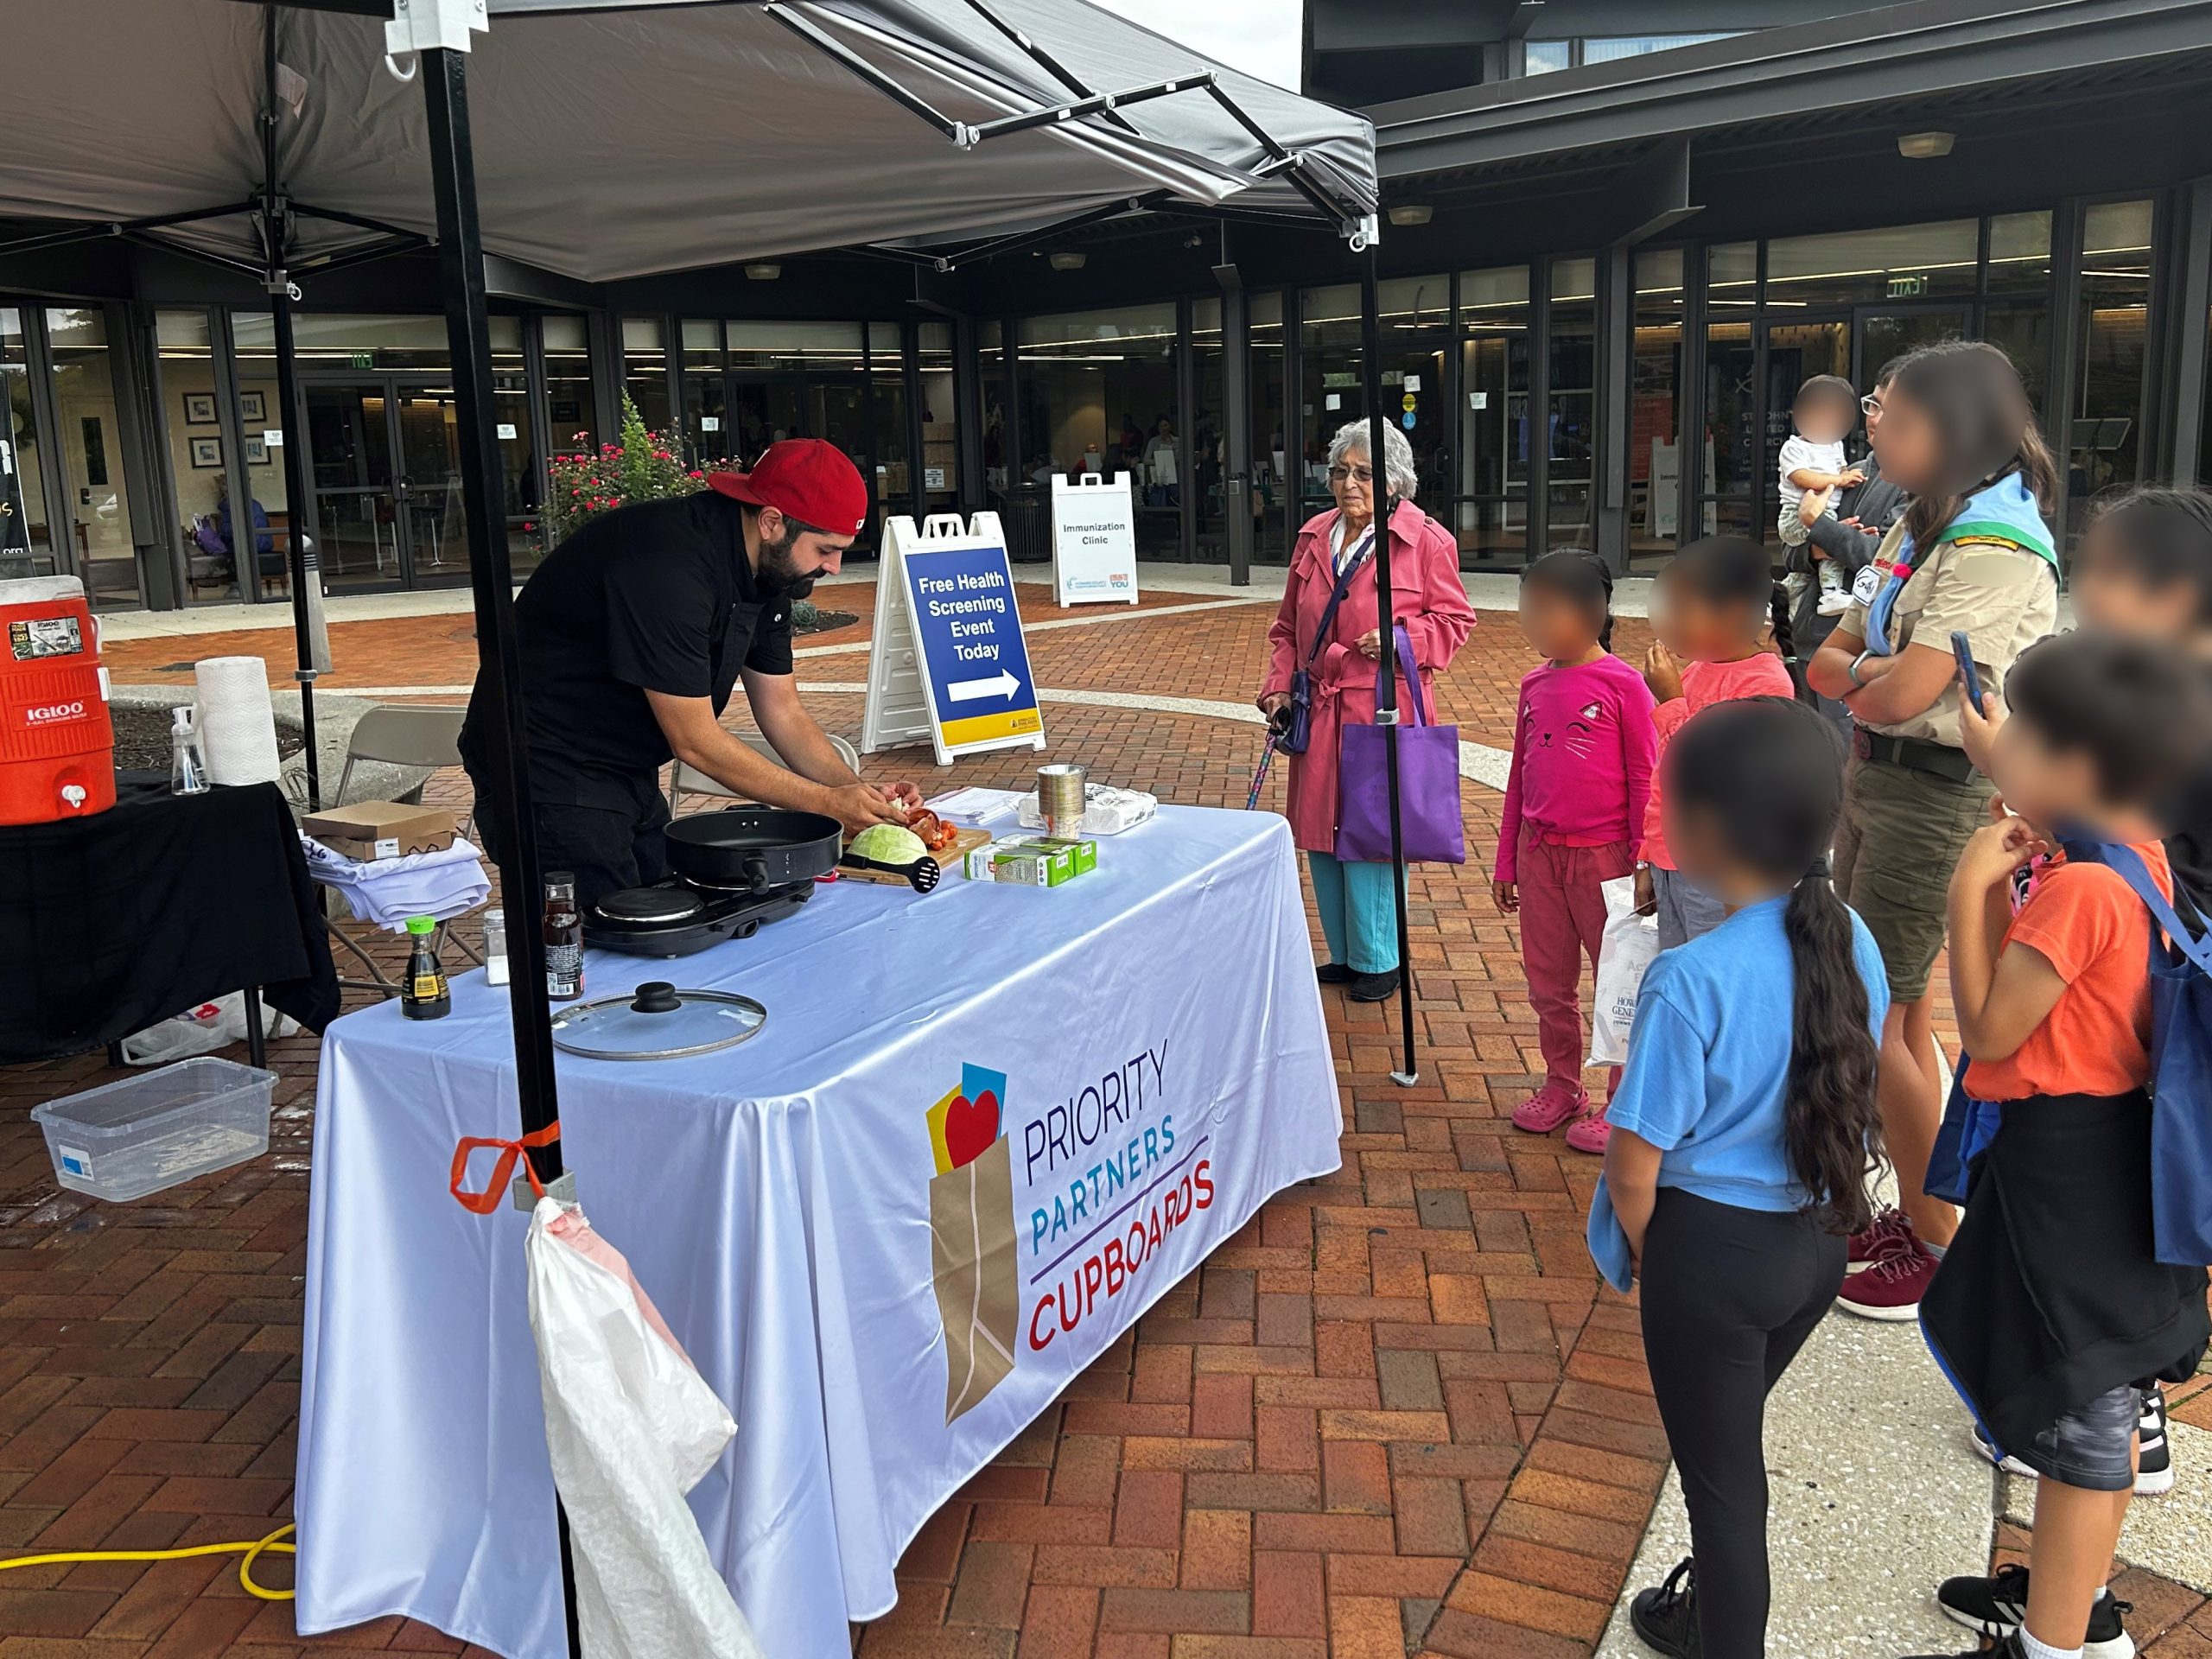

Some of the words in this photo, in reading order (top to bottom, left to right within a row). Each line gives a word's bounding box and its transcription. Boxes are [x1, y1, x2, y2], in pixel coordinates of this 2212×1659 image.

[1745, 424, 1785, 433] UTED
[1744, 437, 1783, 447] CRCH
[1063, 522, 1126, 532] Immunization
[1082, 536, 1109, 545] Clinic
[918, 577, 955, 594] Free
[957, 571, 1005, 590] Health
[929, 595, 1006, 617] Screening
[950, 618, 995, 638] Event
[953, 642, 1000, 661] Today
[27, 702, 84, 721] IGLOO
[1611, 1006, 1636, 1018] GENE
[1025, 1039, 1168, 1187] PRIORITY
[1031, 1115, 1175, 1255] PARTNERS
[1028, 1159, 1215, 1351] CUPBOARDS
